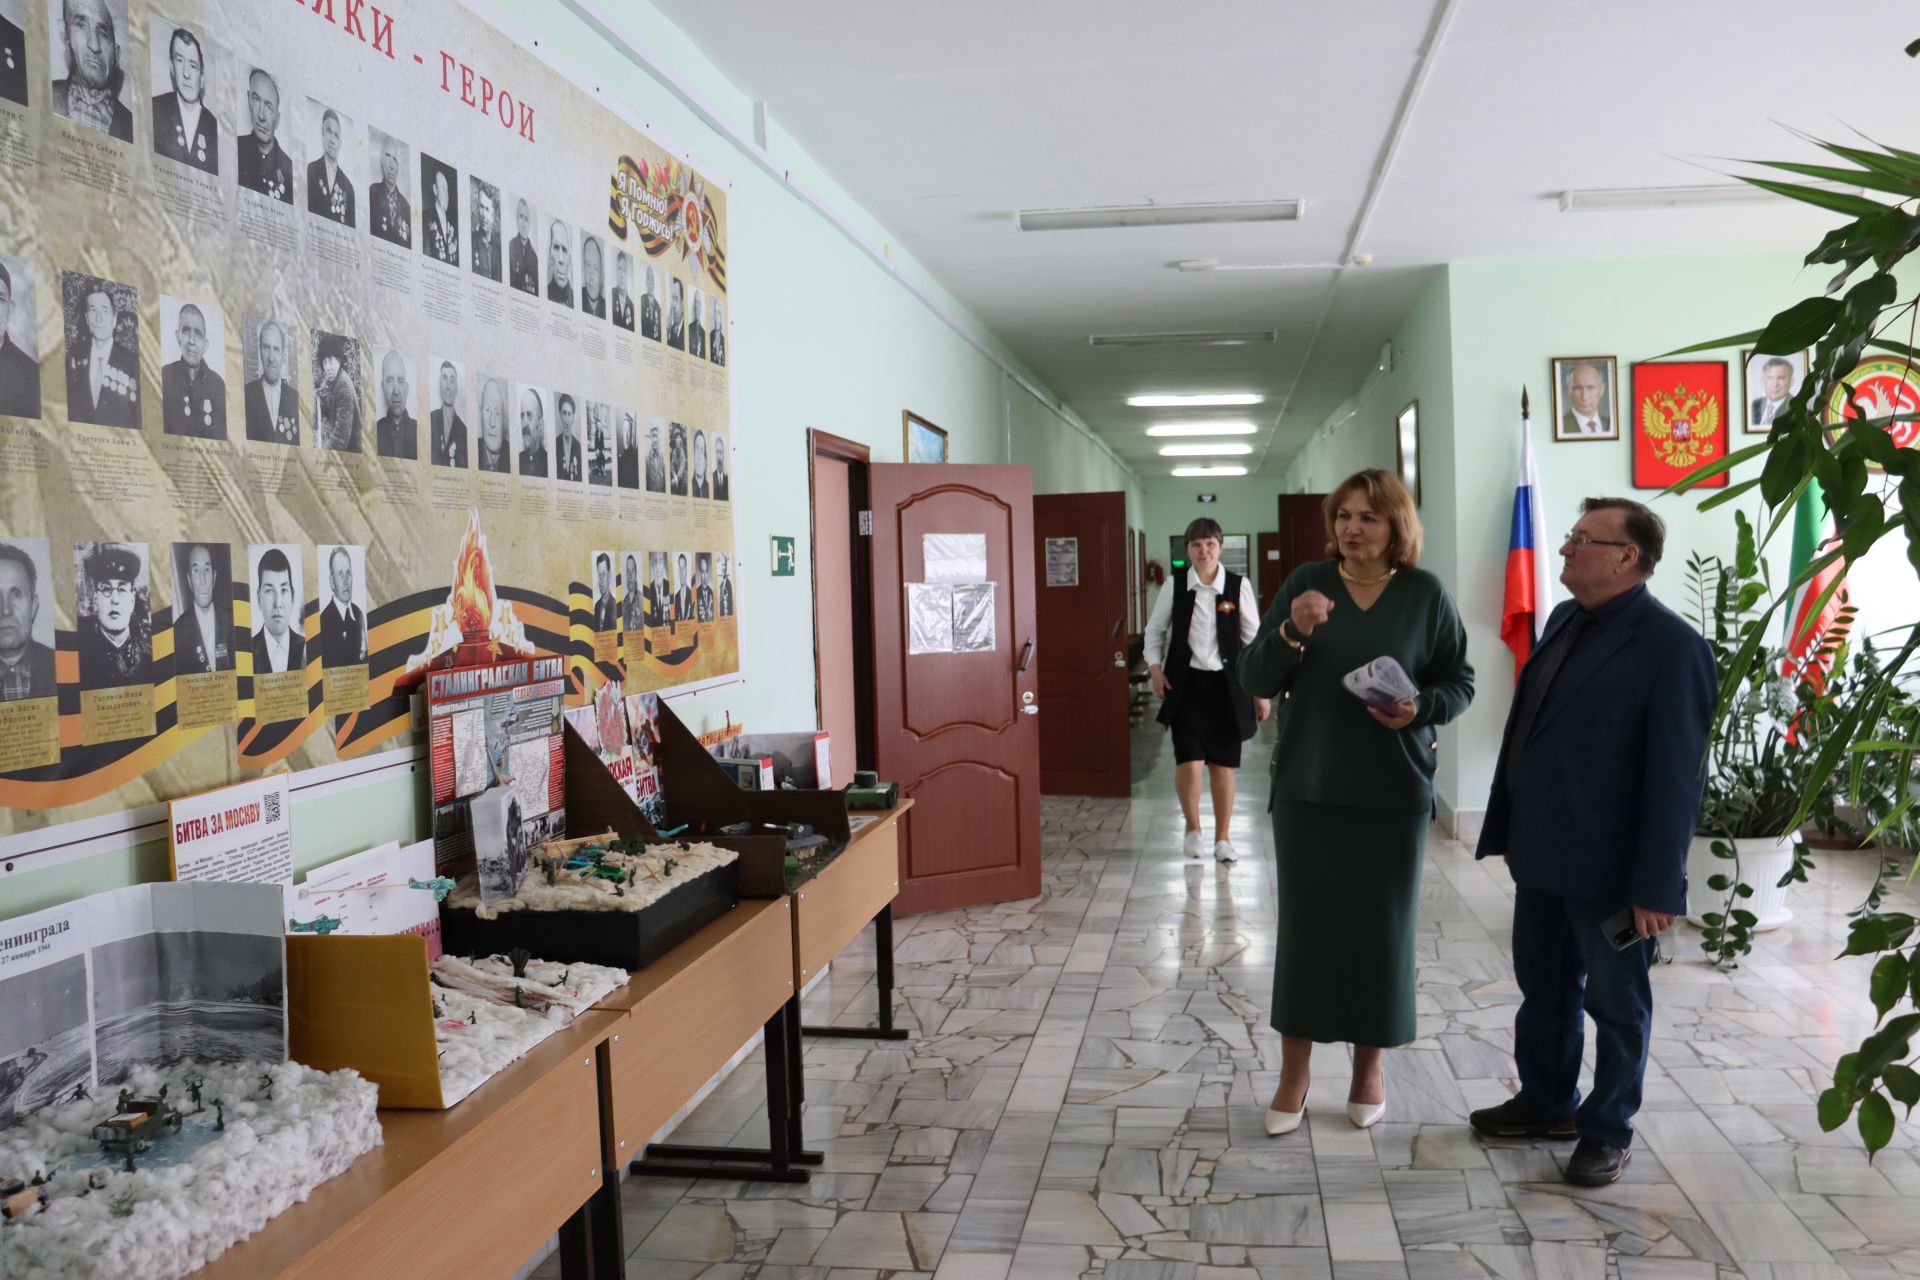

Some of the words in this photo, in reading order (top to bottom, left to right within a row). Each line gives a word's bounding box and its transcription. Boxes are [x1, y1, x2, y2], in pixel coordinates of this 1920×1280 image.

[439, 50, 535, 143] ГЕРОИ
[618, 171, 627, 192] Я
[621, 196, 629, 218] Я
[431, 662, 529, 700] СТАЛИНГРАДСКАЯ
[533, 657, 563, 682] БИТВА
[175, 817, 209, 845] БИТВА
[211, 813, 224, 835] ЗА
[224, 802, 261, 831] МОСКВУ
